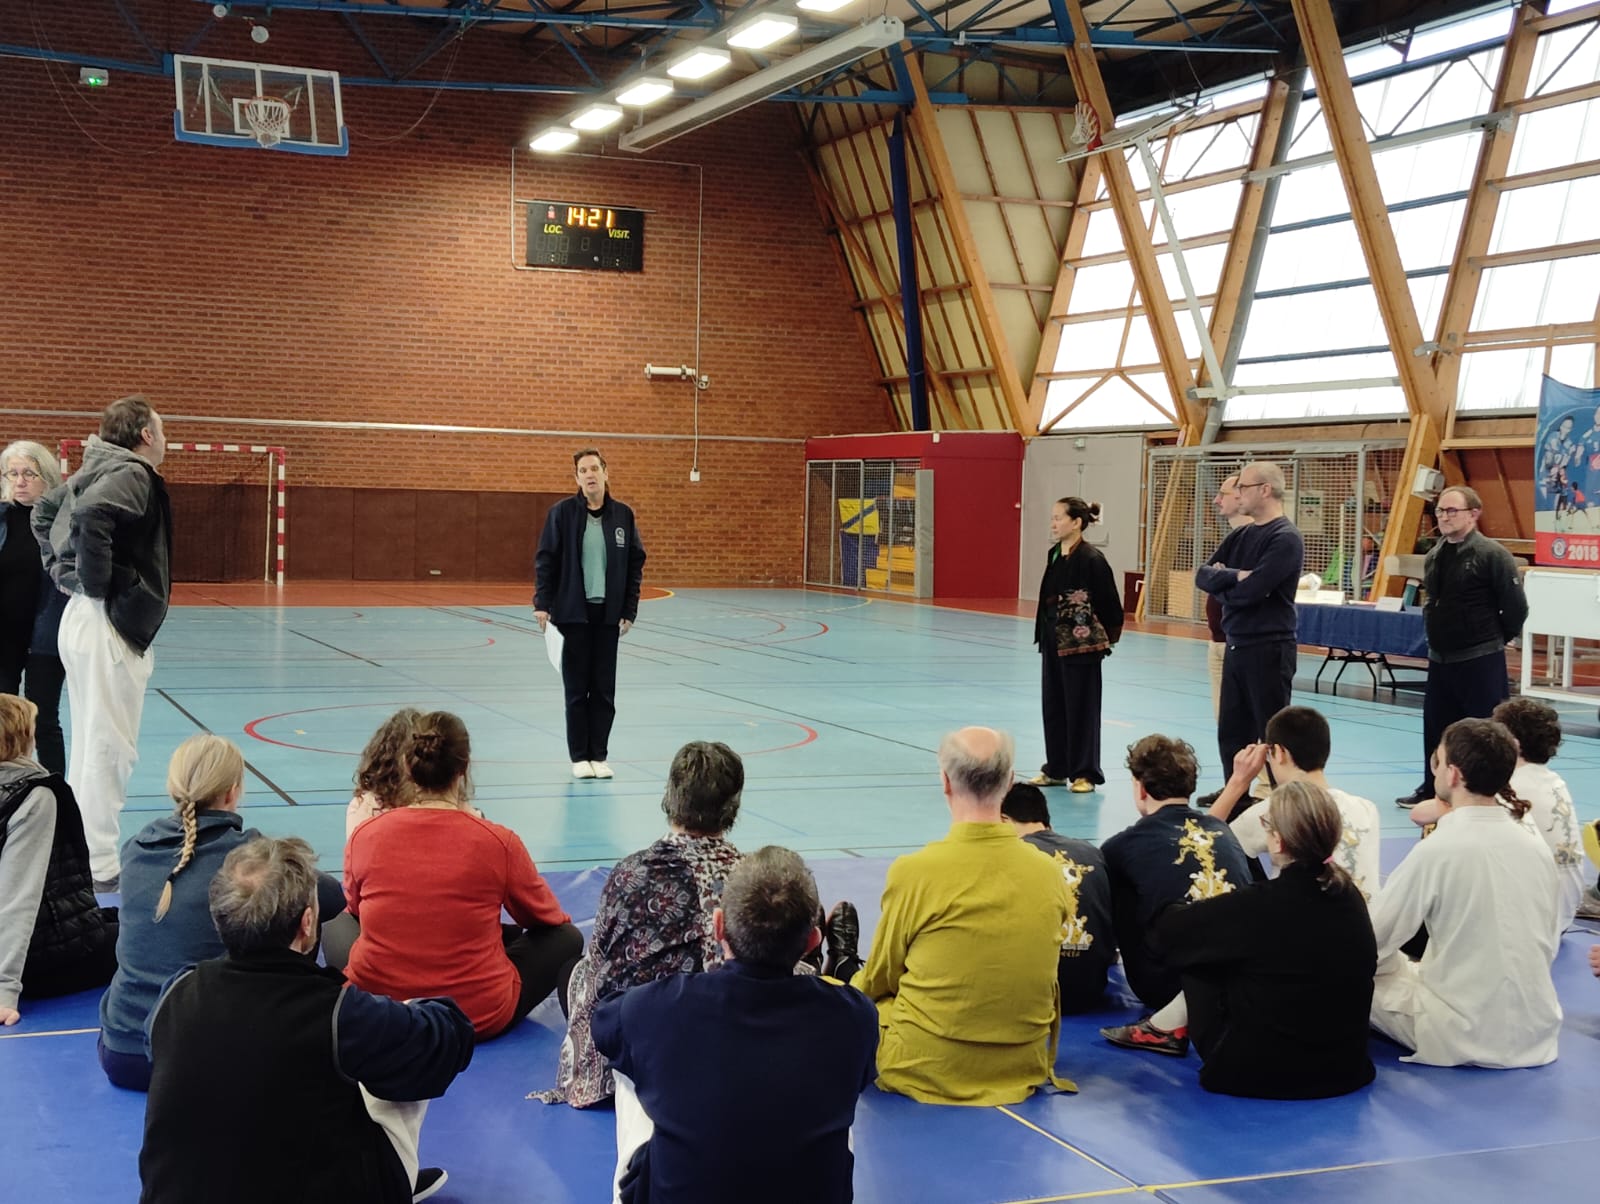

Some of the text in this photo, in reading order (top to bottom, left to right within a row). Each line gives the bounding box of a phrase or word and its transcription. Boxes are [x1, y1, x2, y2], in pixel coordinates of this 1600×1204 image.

[543, 223, 564, 235] LOC.
[608, 228, 630, 239] VISIT.
[1568, 544, 1599, 561] 2018
